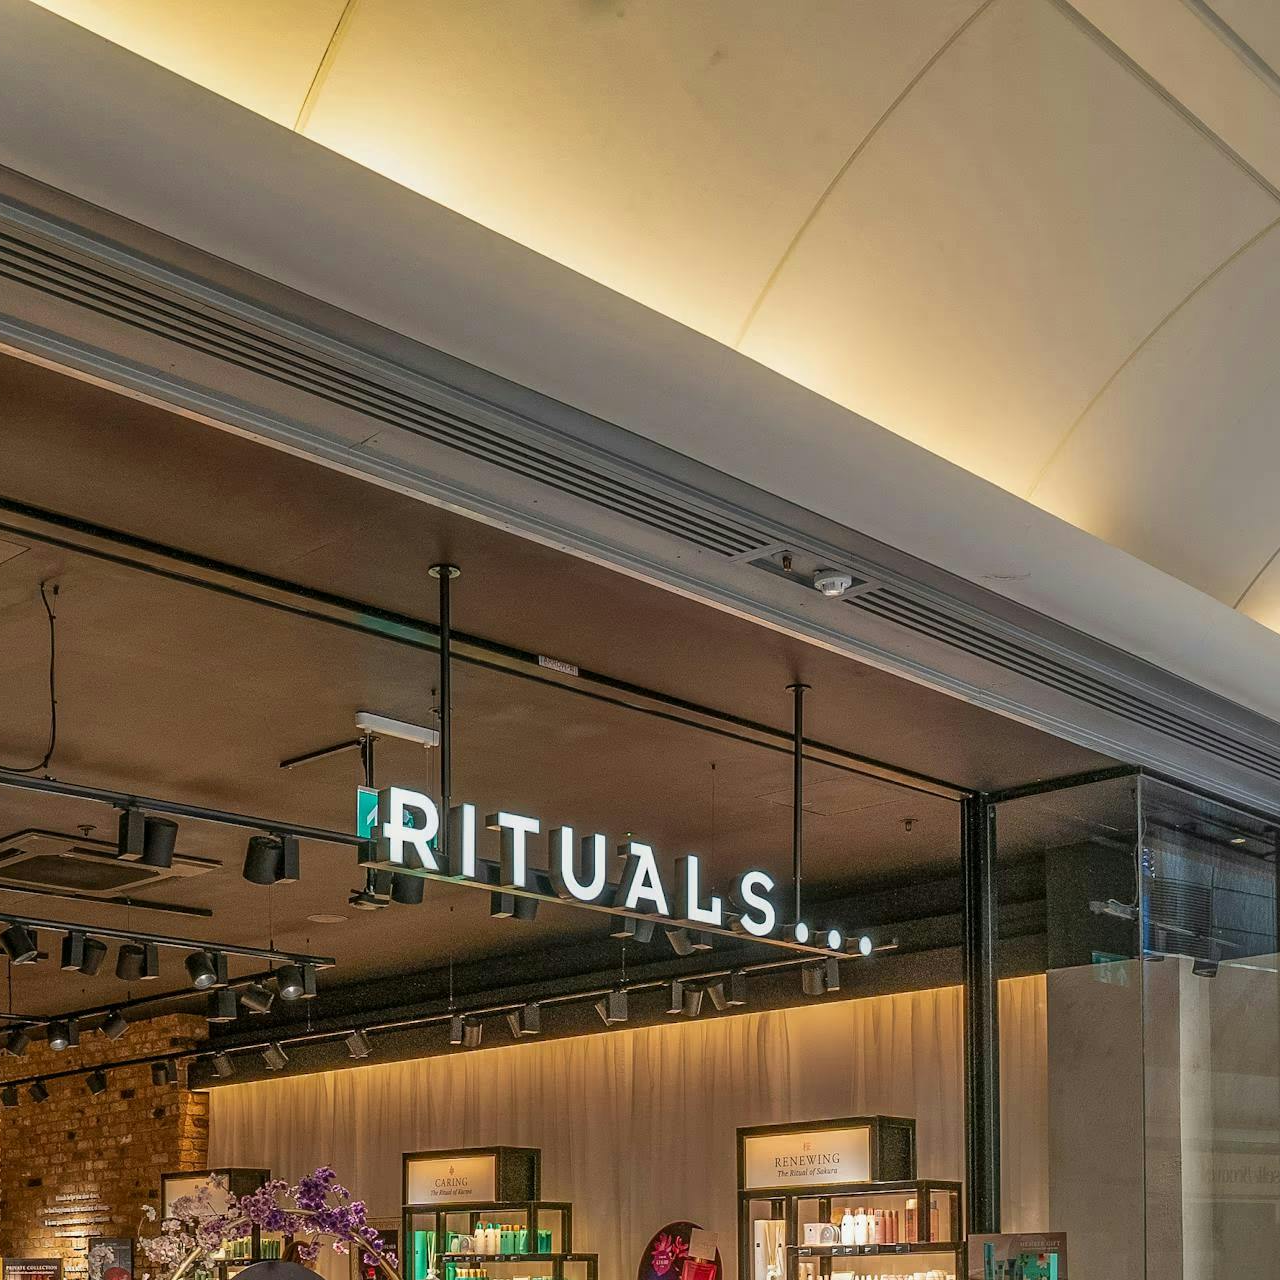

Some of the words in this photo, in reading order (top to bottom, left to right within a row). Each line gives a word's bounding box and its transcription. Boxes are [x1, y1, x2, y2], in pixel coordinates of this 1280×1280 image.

[382, 785, 873, 957] RITUALS...
[775, 1153, 840, 1167] RENEWING
[790, 1168, 808, 1176] Ritual
[809, 1168, 816, 1176] of
[816, 1167, 837, 1175] Sakura
[435, 1177, 468, 1187] CARING
